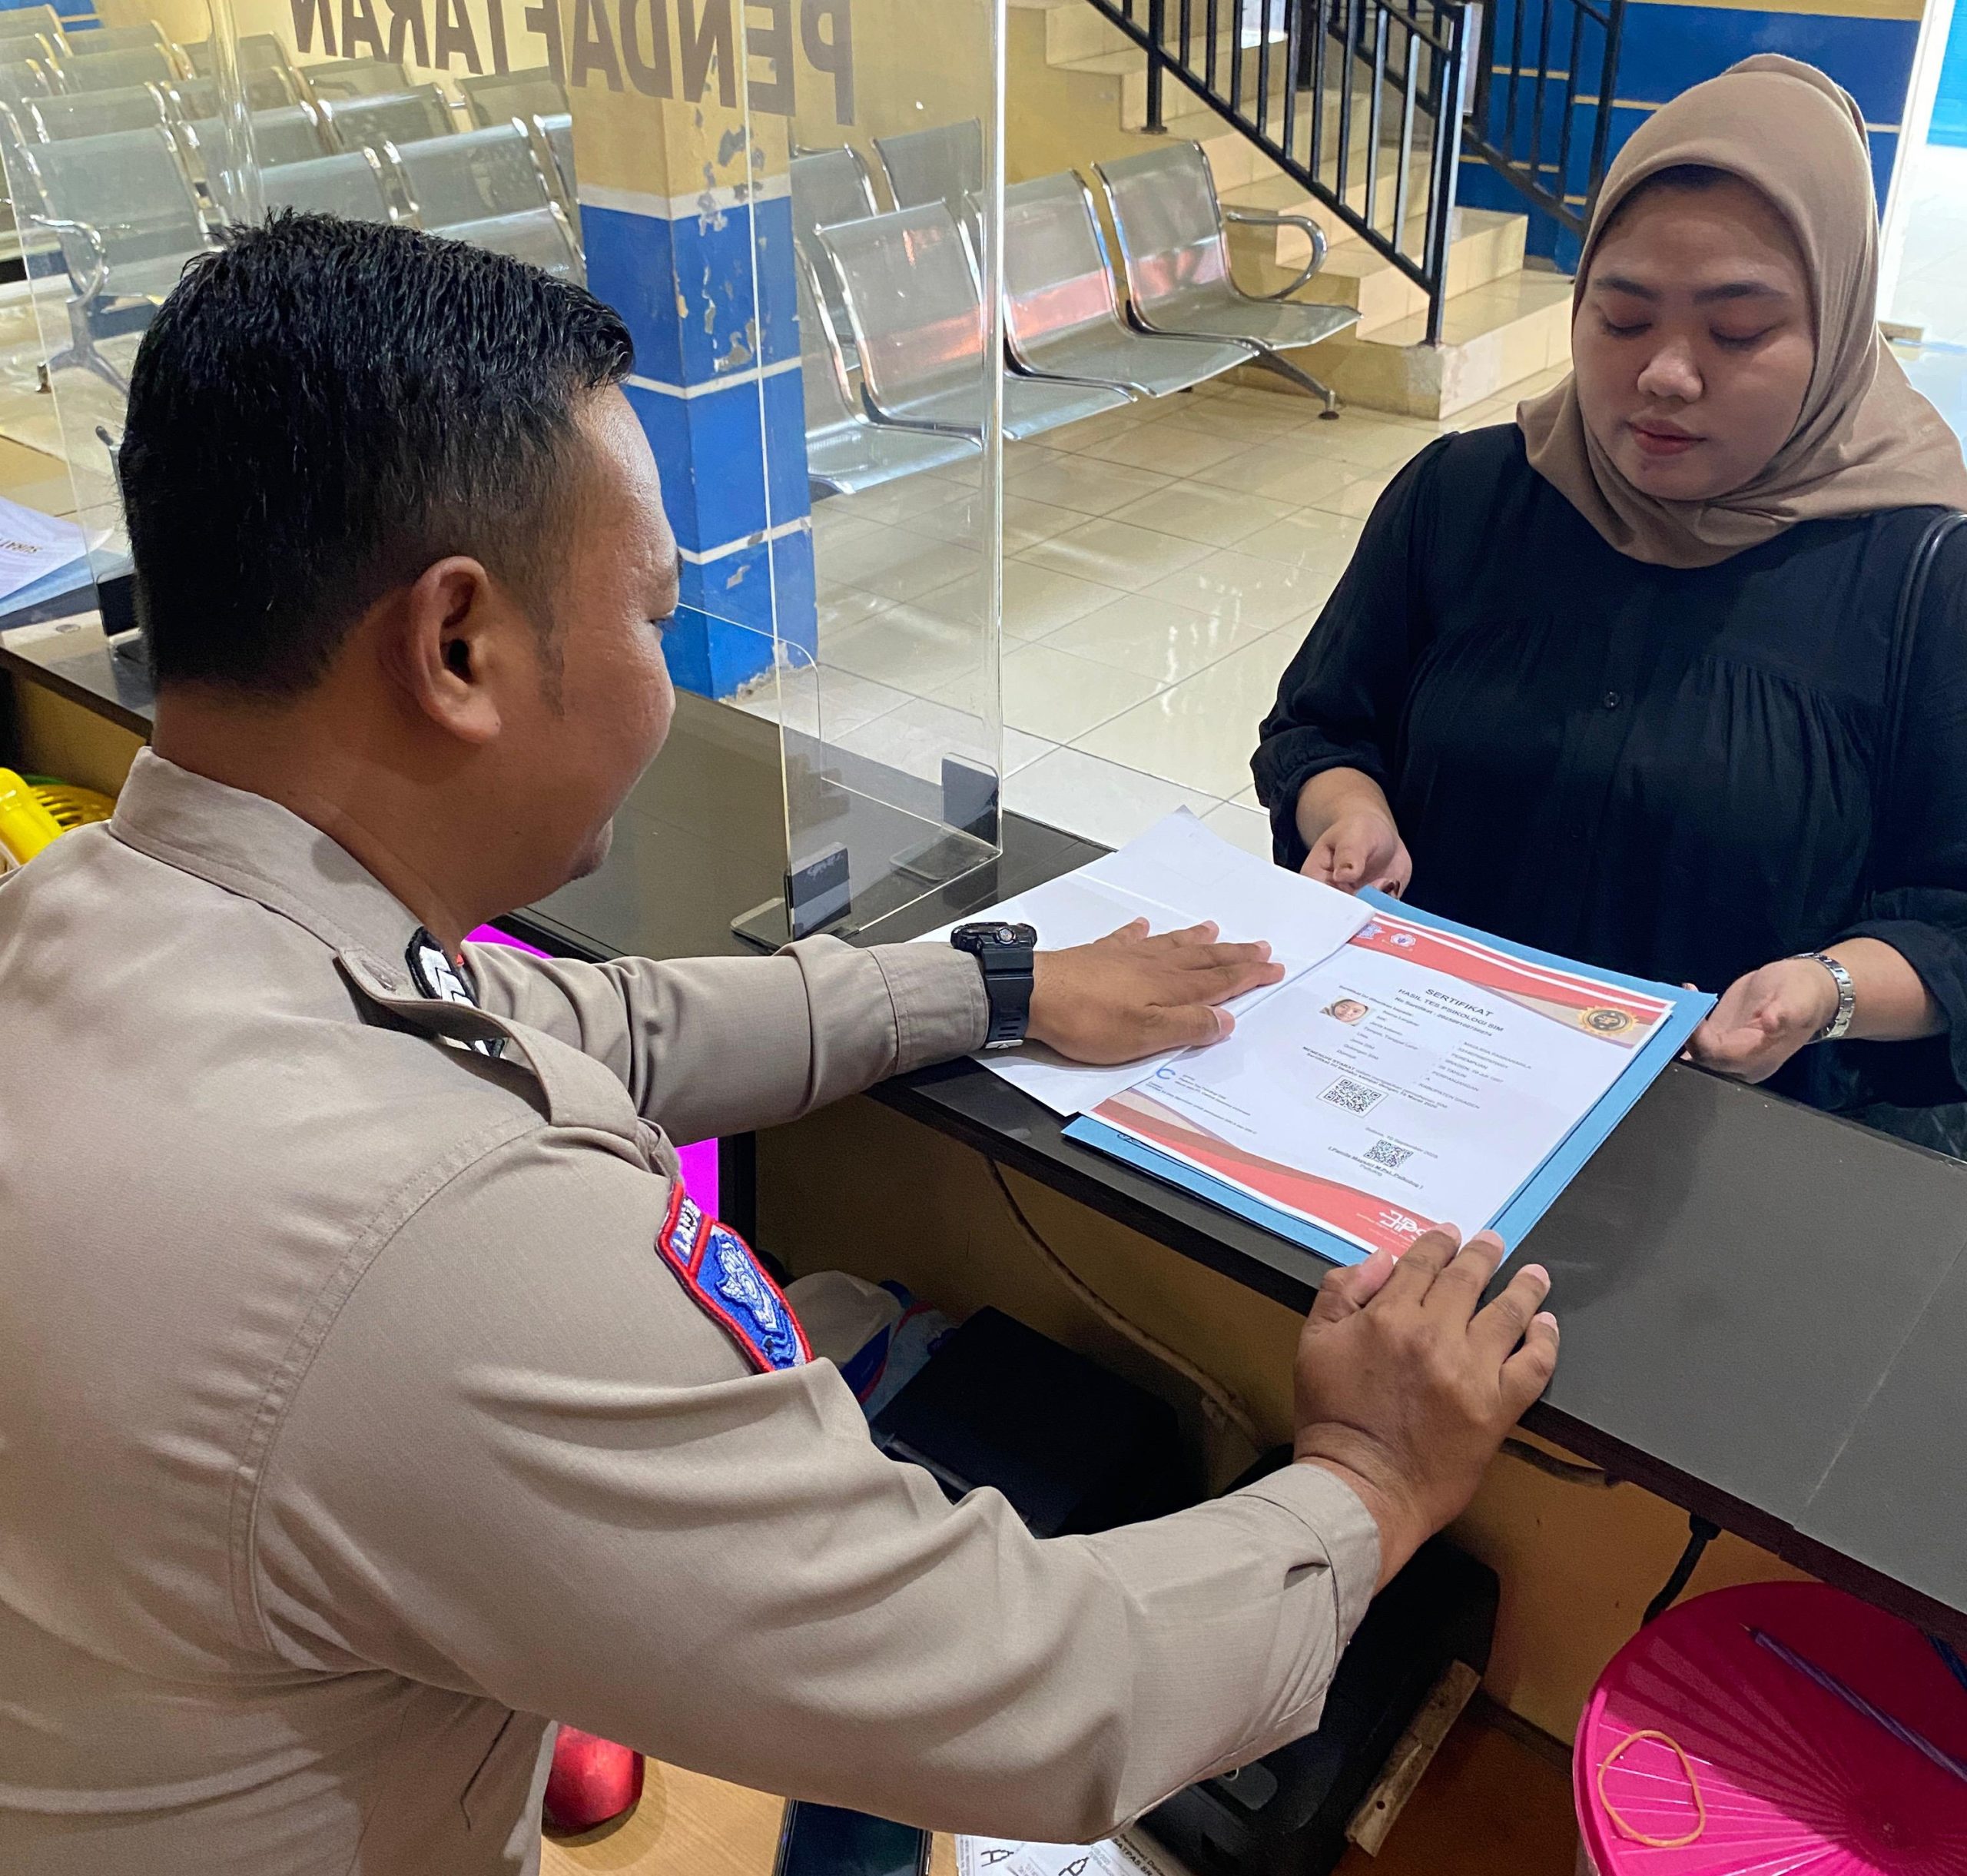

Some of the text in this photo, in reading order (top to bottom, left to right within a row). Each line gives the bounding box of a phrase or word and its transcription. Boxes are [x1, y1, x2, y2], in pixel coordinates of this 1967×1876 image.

[1398, 988, 1421, 1001] HASIL
[1424, 999, 1440, 1008] TES
[1441, 1005, 1488, 1026] PSIKOLOGI
[1488, 1023, 1504, 1032] SIM
[1425, 988, 1494, 1017] SERTIFIKAT
[1113, 1838, 1141, 1866] SATPAS
